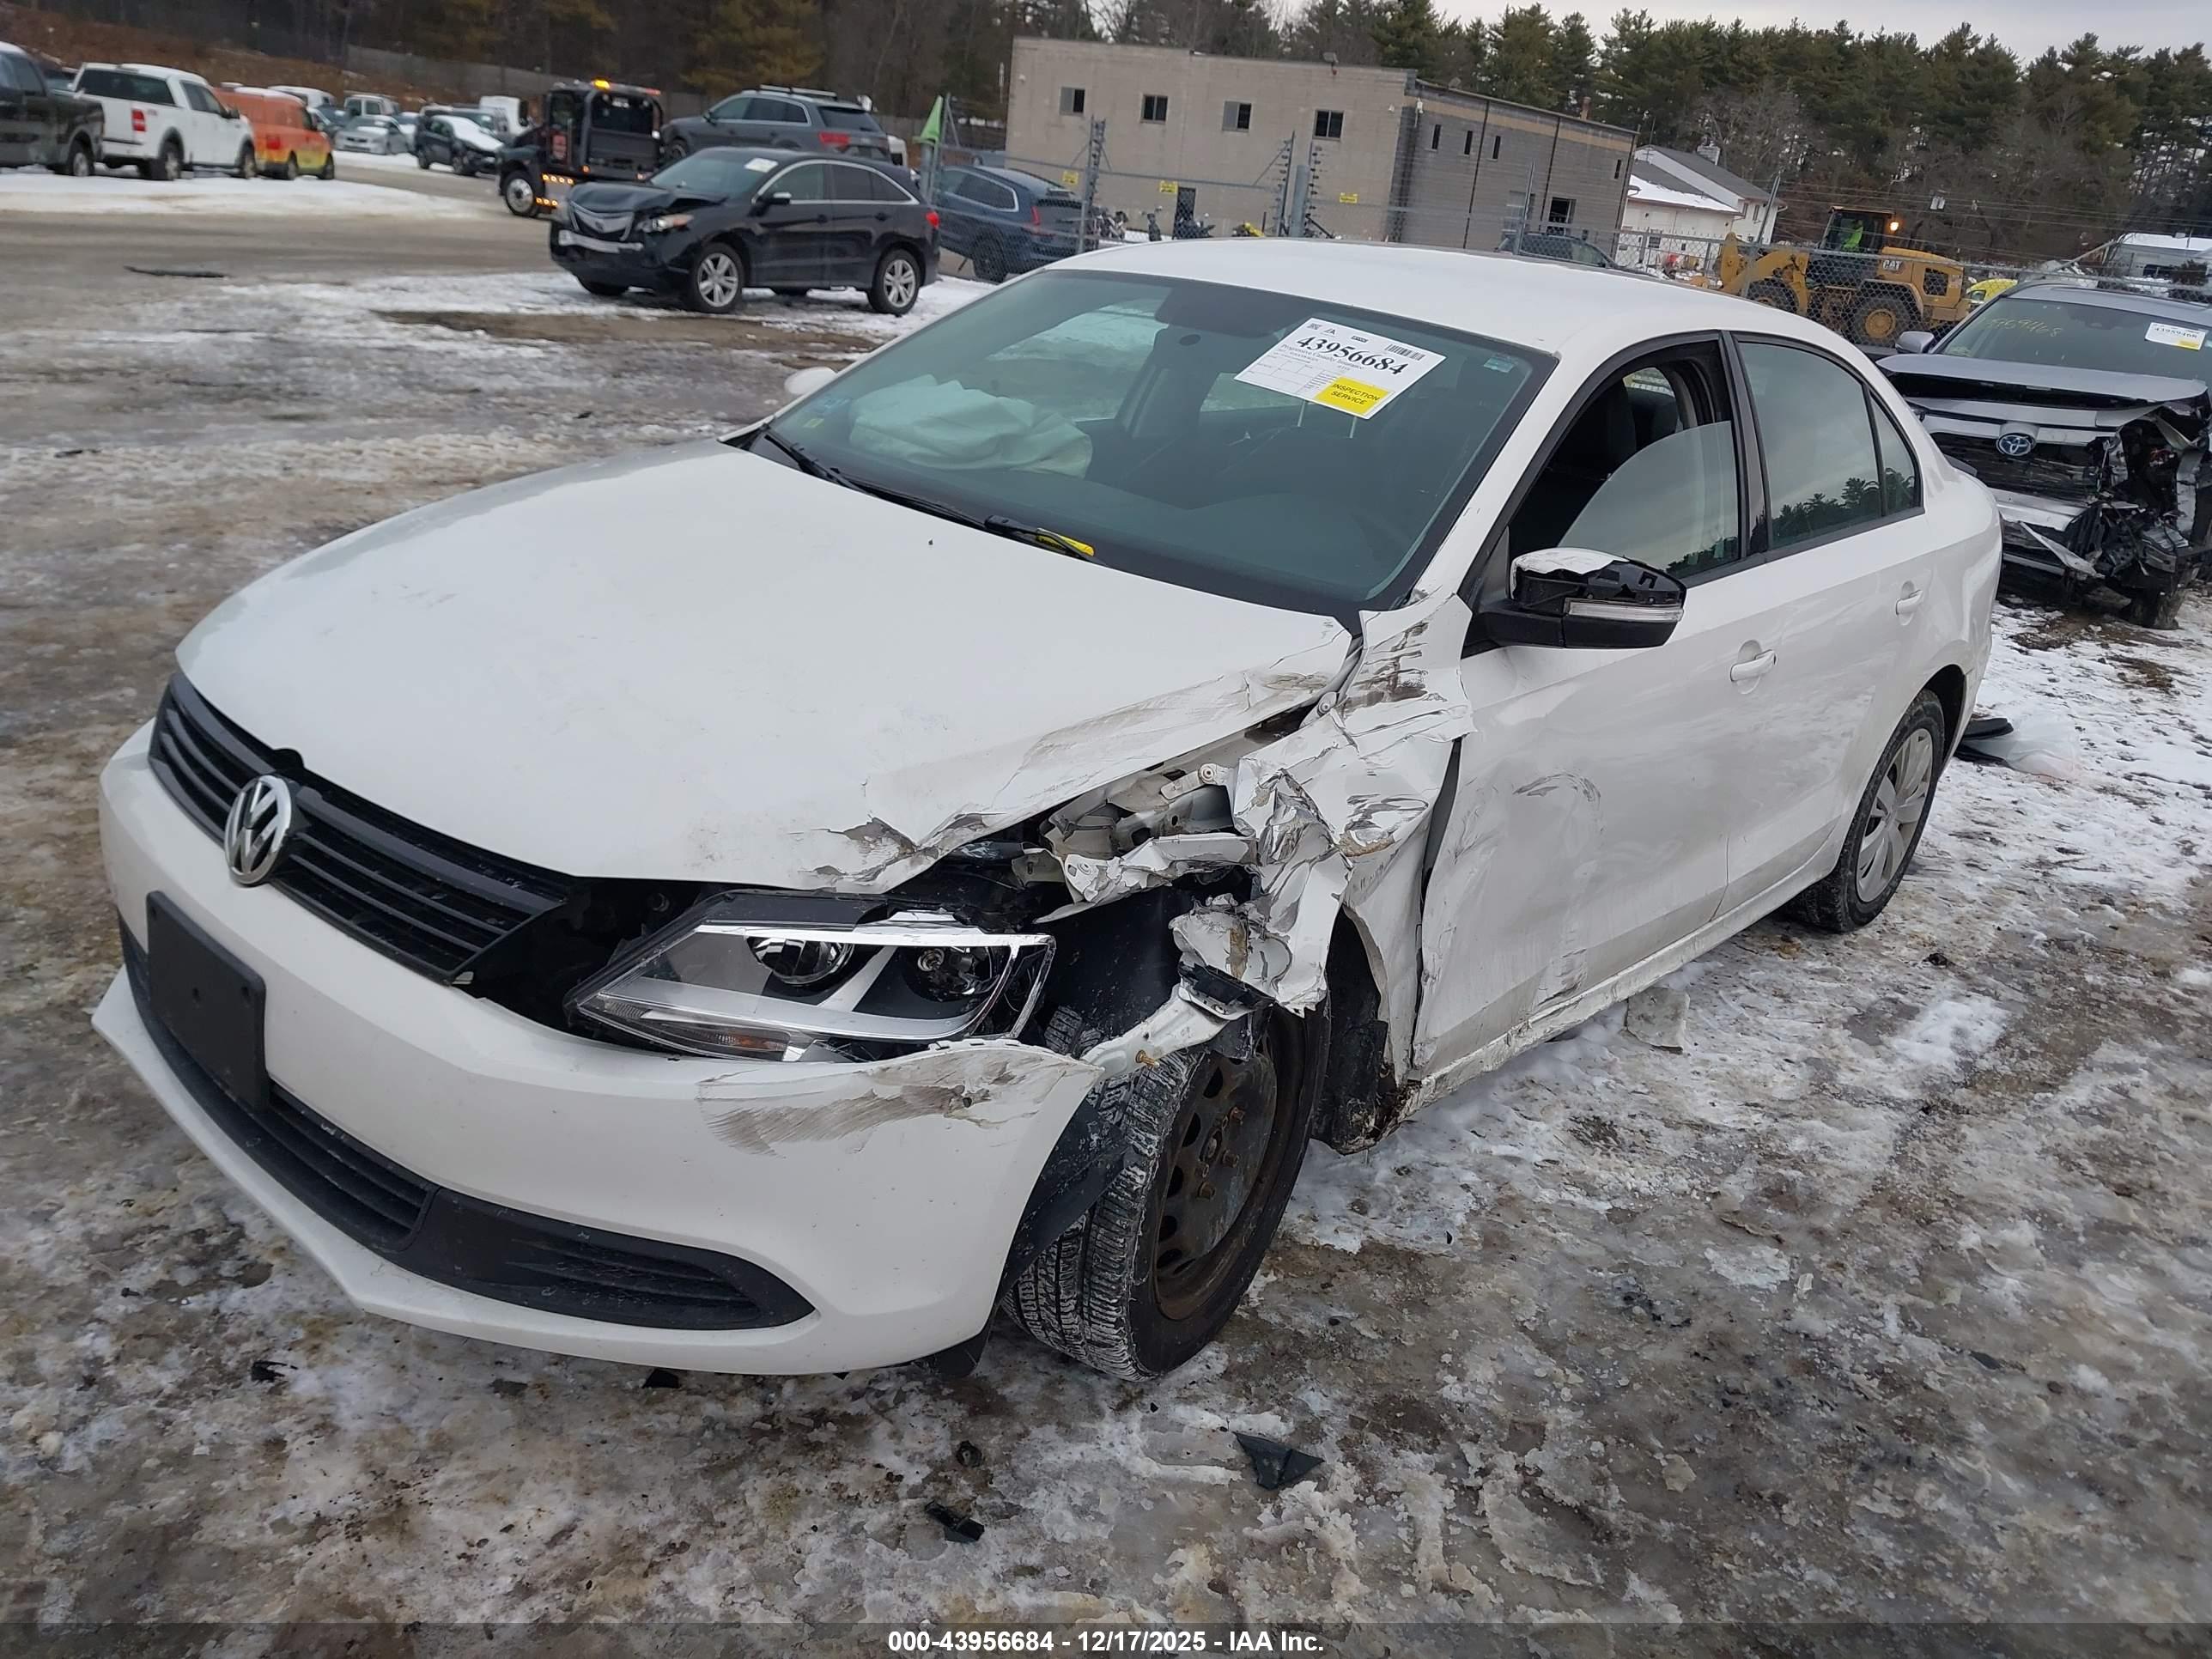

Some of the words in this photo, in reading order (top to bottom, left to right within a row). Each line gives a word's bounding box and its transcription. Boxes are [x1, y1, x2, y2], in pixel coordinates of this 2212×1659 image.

[1882, 259, 1903, 271] CAT
[1297, 336, 1408, 375] 43956684
[1331, 390, 1368, 405] SERVICE
[1333, 383, 1380, 402] INSPECTION
